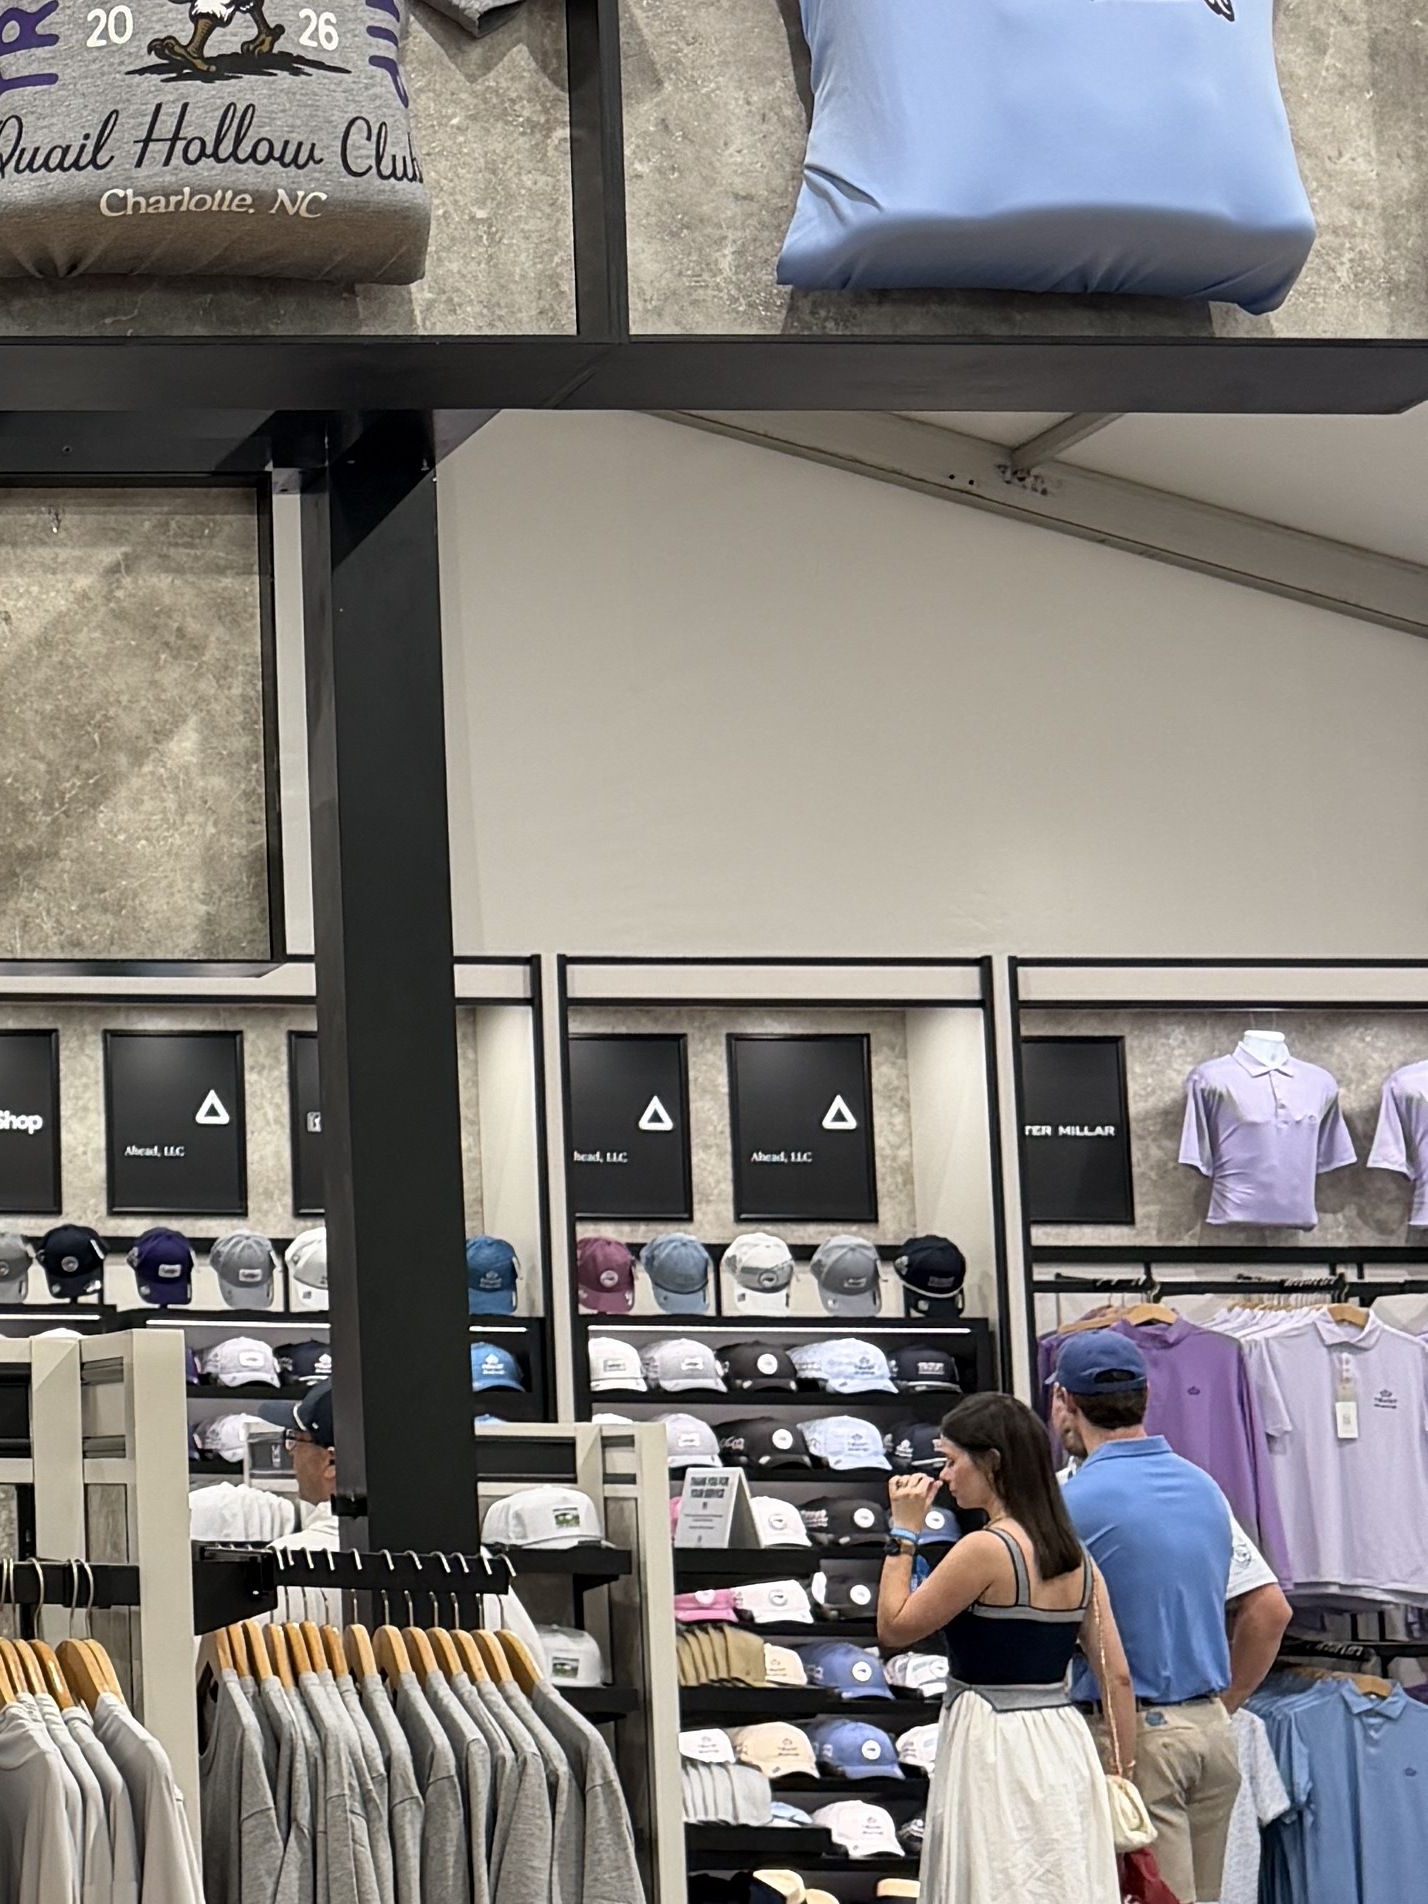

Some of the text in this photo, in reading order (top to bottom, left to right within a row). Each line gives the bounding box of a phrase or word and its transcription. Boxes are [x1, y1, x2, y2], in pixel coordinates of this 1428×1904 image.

[86, 5, 339, 51] 20 26
[133, 101, 324, 170] Hollow
[268, 188, 328, 218] NC
[1024, 1125, 1115, 1137] TER MILLAR
[124, 1145, 185, 1158] Ahead, LLC
[574, 1150, 629, 1164] head, LLC
[751, 1151, 813, 1164] Ahead, LLC
